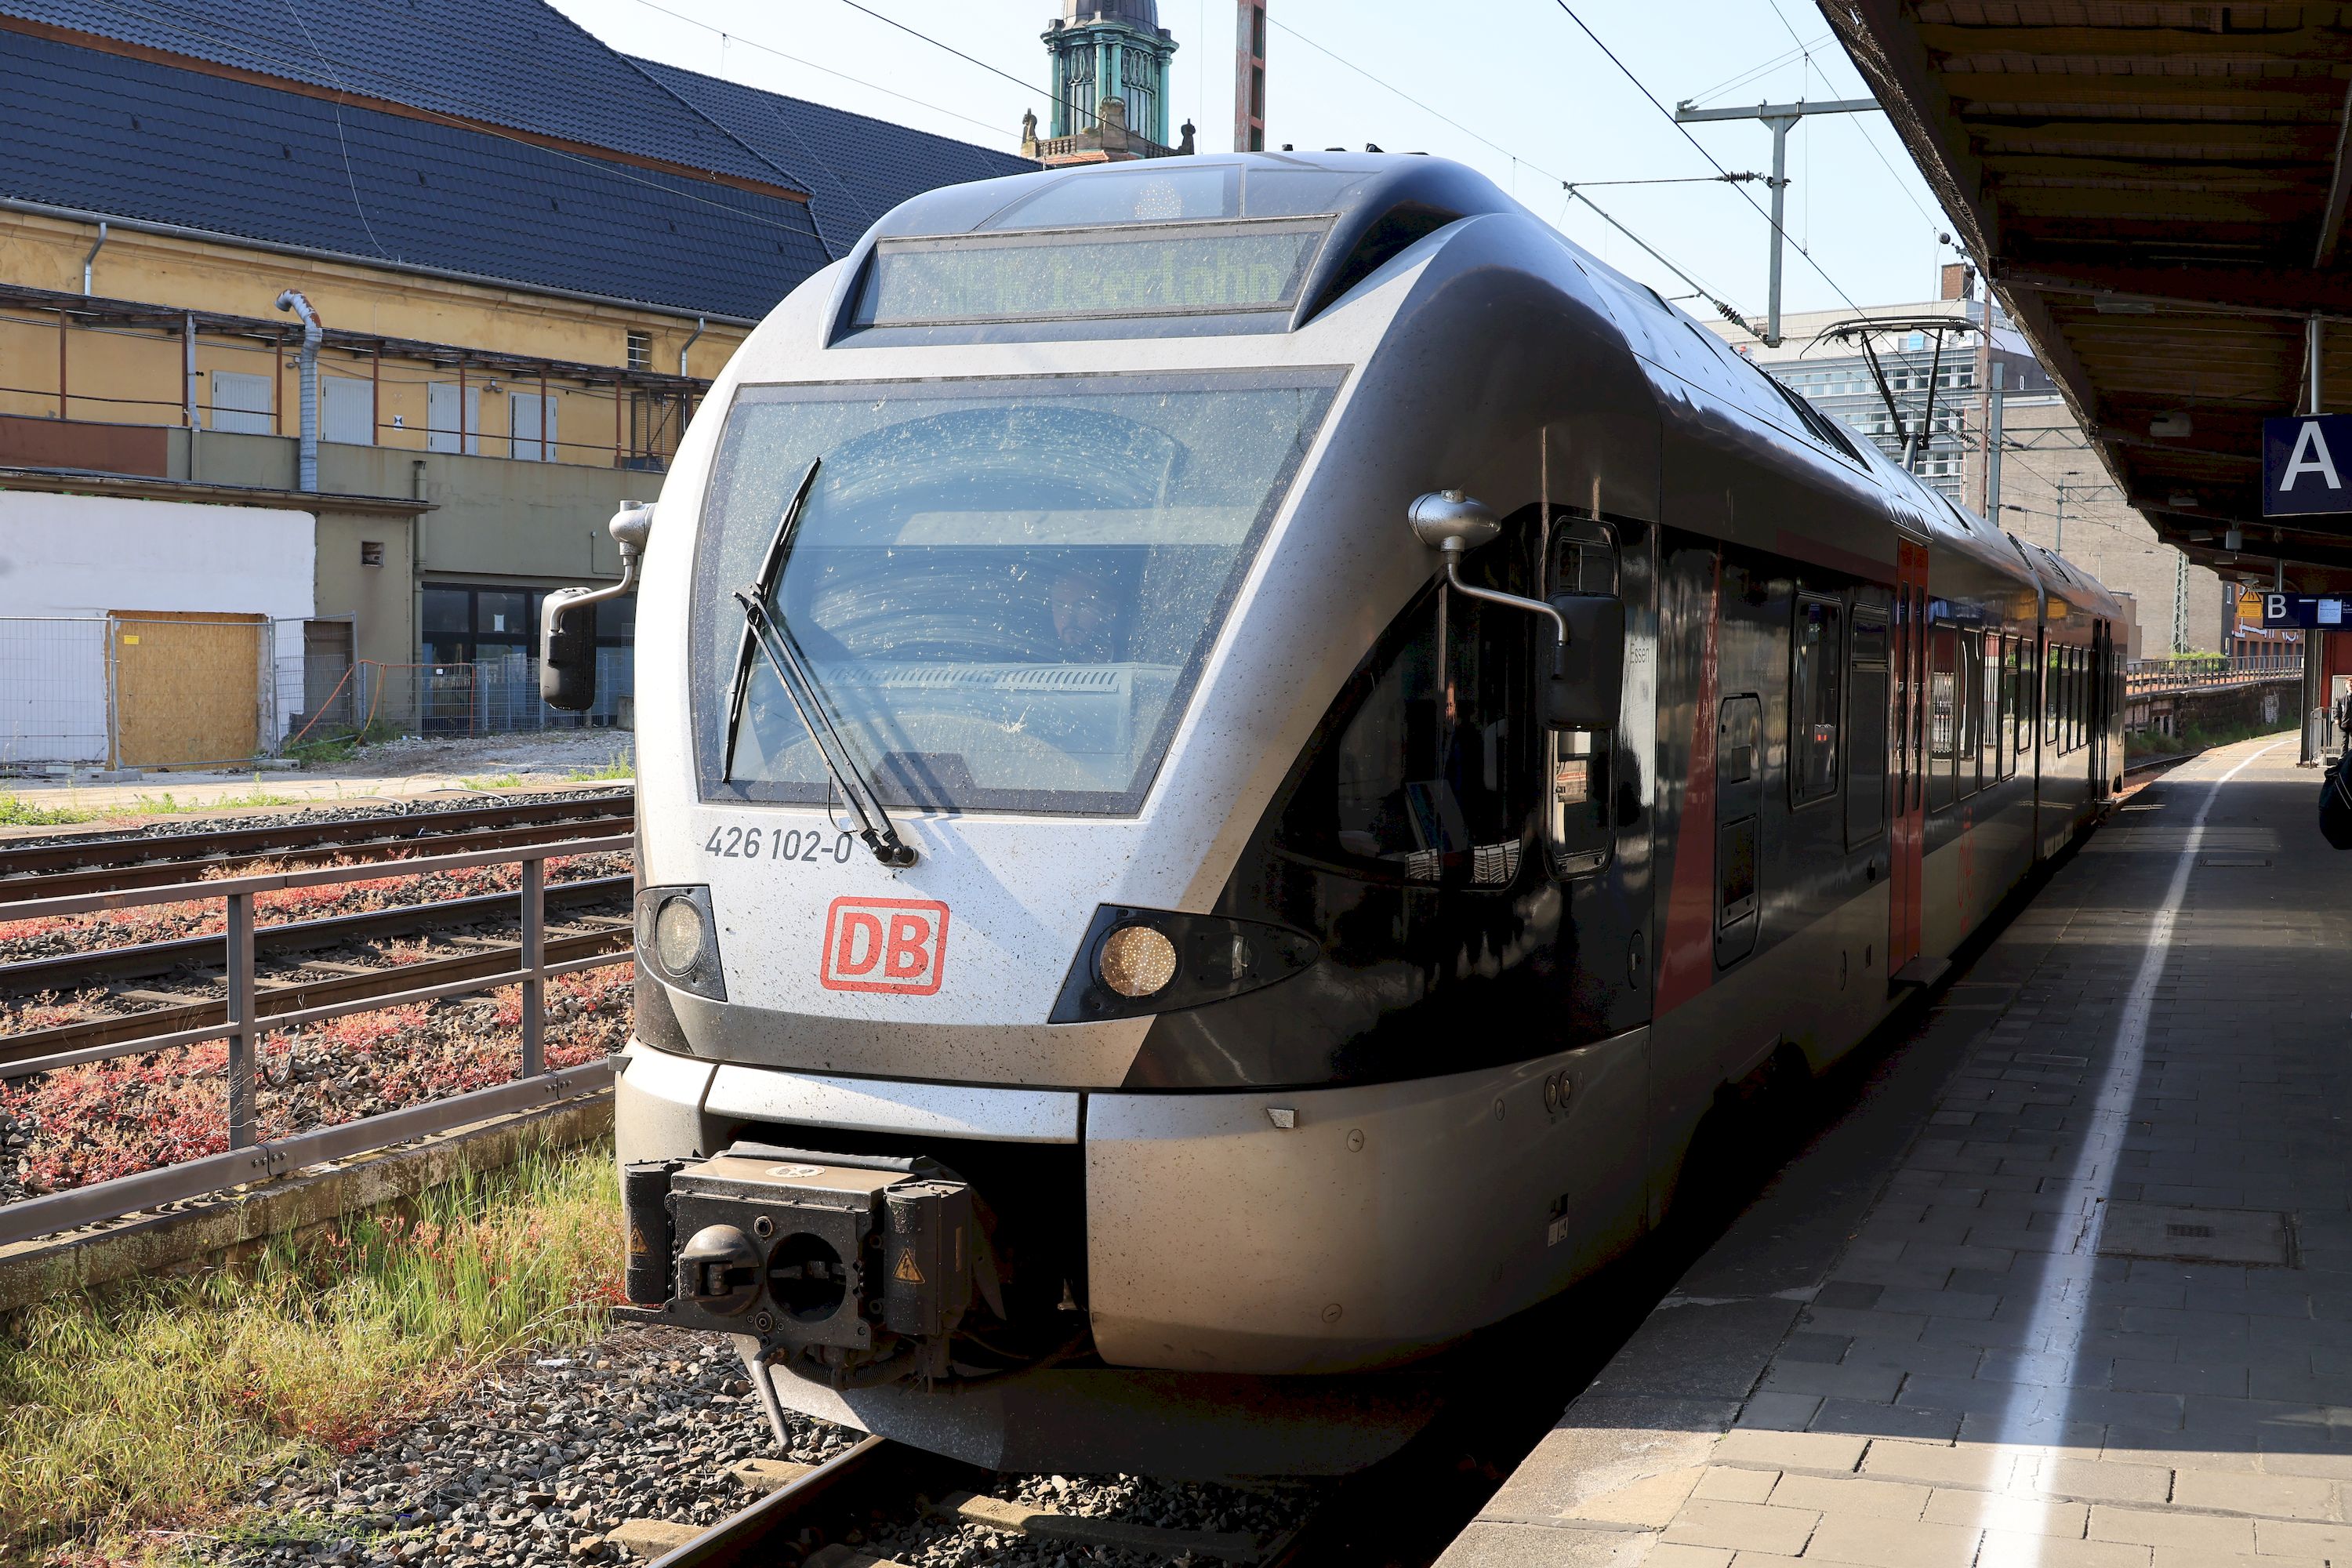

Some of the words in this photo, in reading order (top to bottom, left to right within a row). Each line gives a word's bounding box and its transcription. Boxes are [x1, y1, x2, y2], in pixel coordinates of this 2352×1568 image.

[1047, 246, 1280, 311] Iserlohn
[2279, 421, 2342, 492] A
[2267, 594, 2287, 619] B
[1630, 643, 1650, 664] Essen
[705, 826, 762, 859] 426
[771, 829, 853, 864] 102-0
[835, 910, 932, 980] DB
